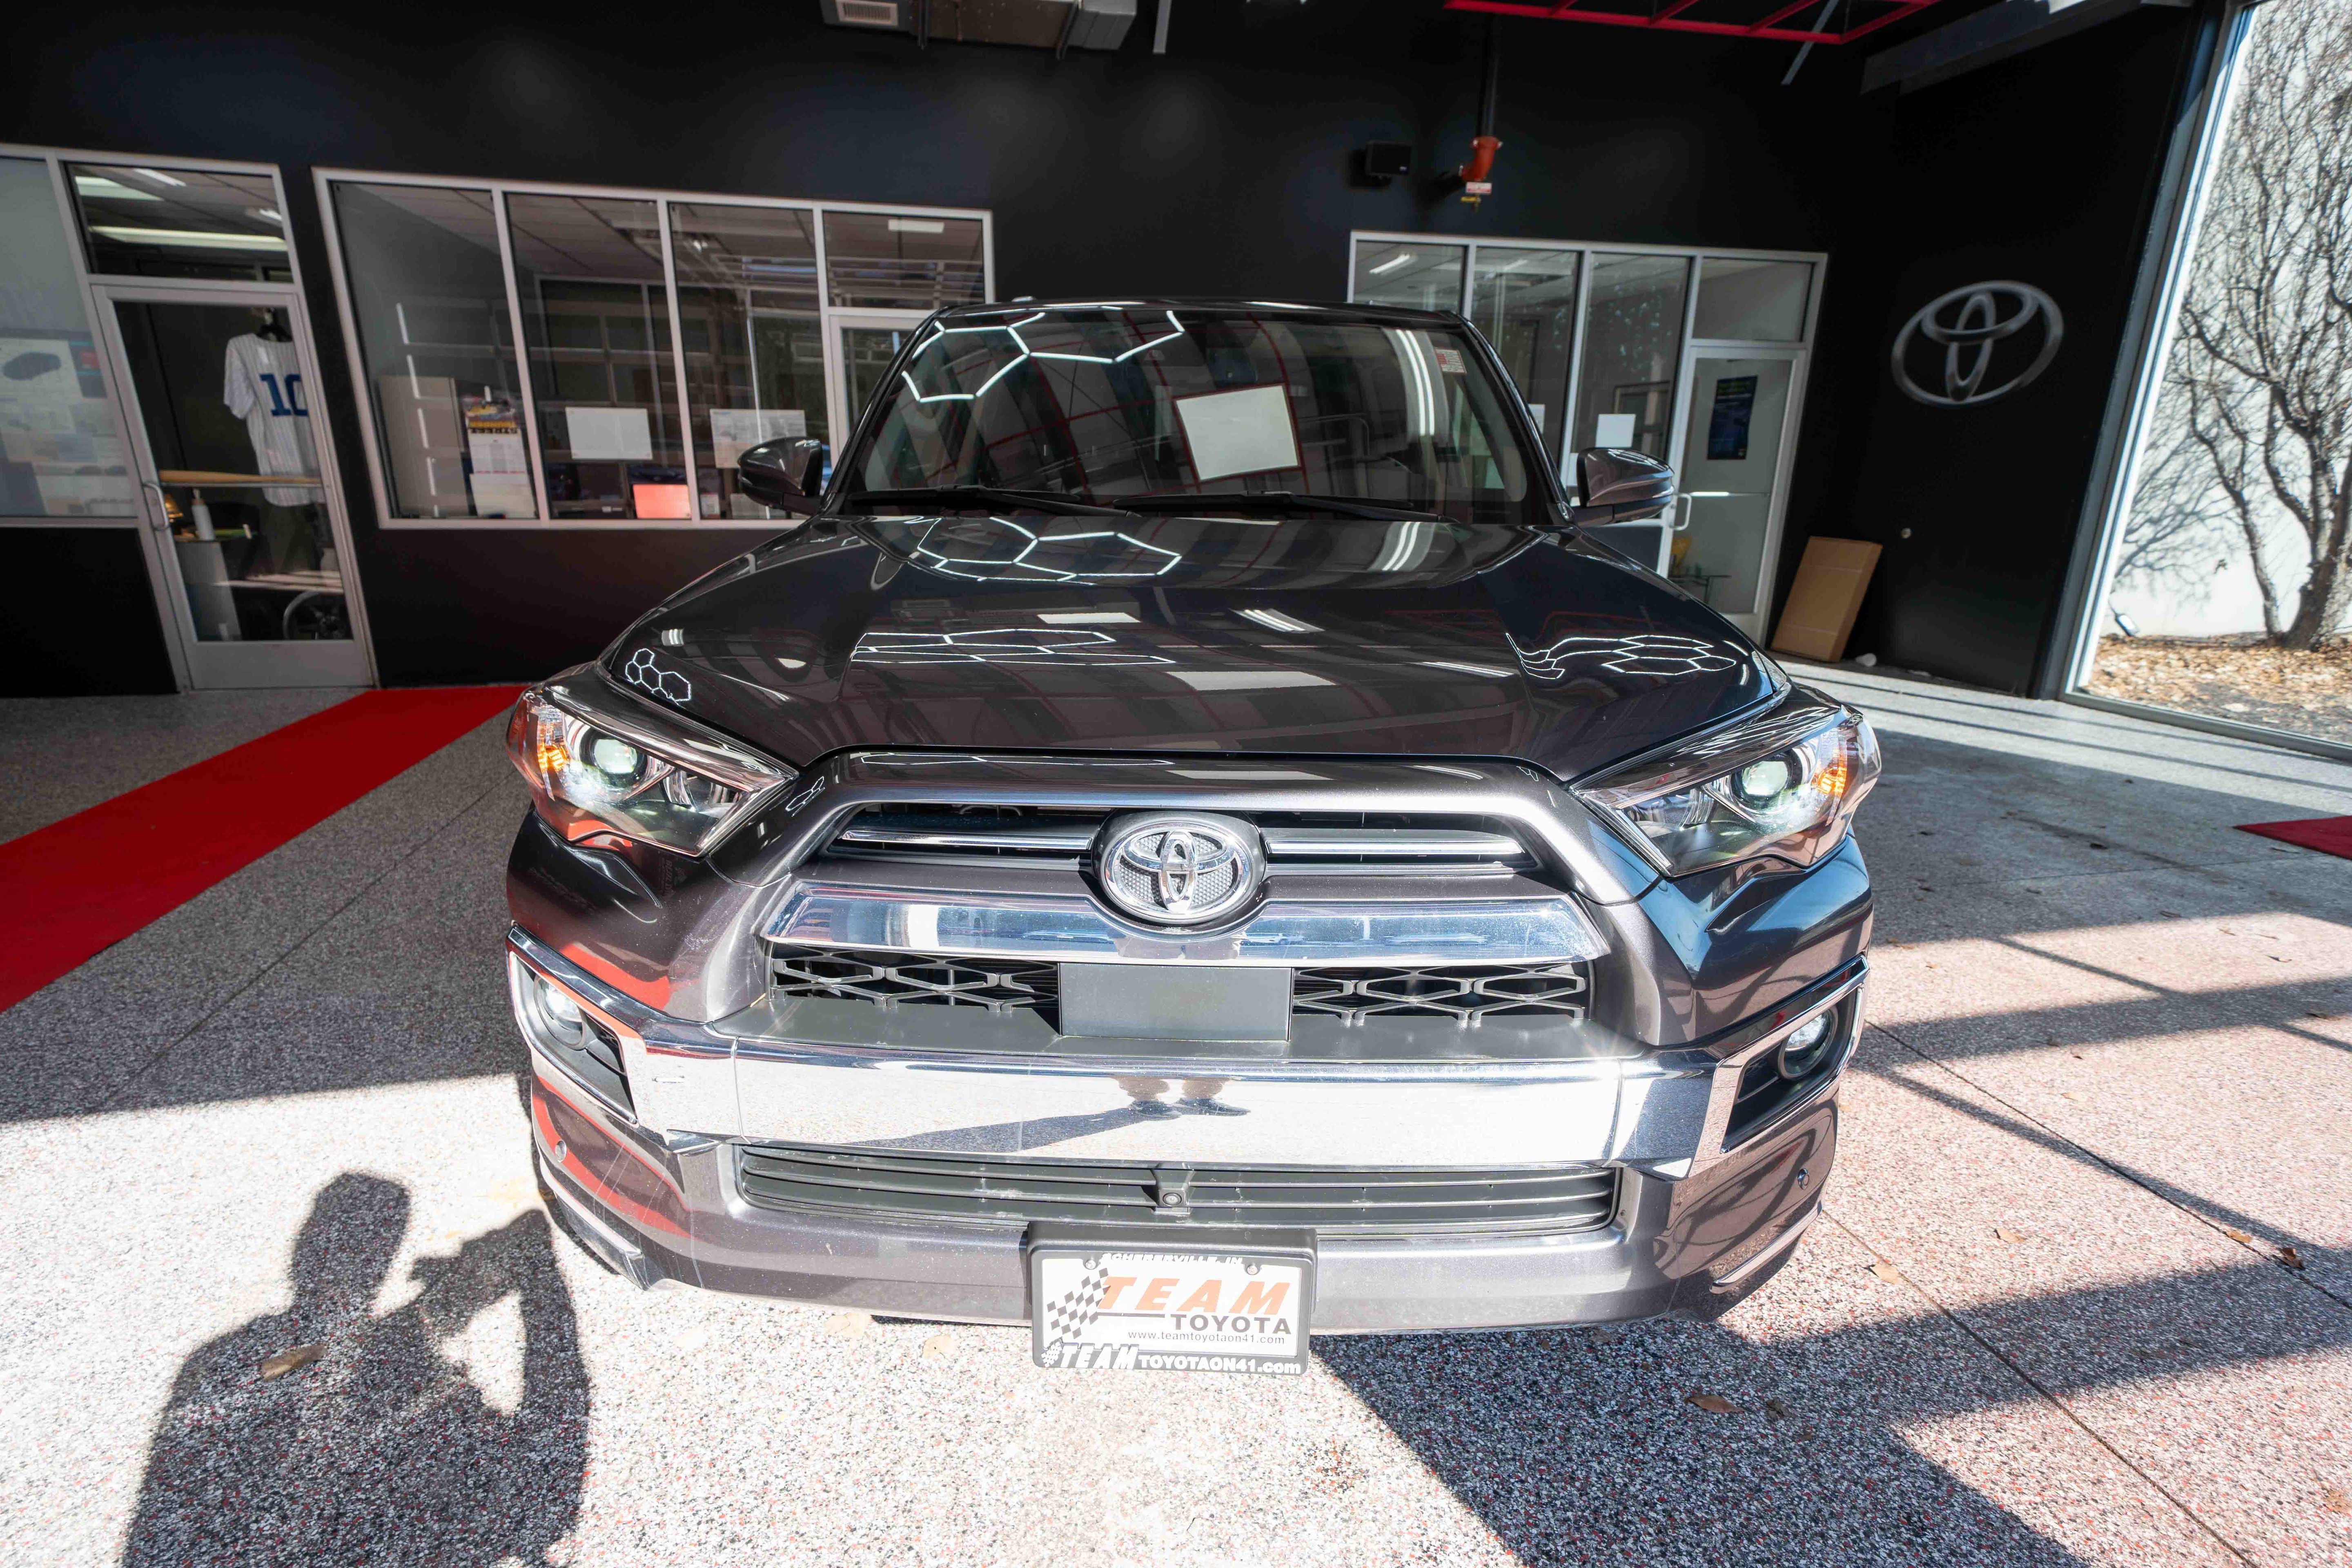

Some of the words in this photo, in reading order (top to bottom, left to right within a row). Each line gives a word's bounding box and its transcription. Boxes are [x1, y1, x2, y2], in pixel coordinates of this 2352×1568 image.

[1097, 1276, 1290, 1315] TEAM
[1170, 1314, 1291, 1334] TOYOTA
[1128, 1330, 1285, 1345] www.teamtoyotaon41.com
[1060, 1343, 1139, 1370] TEAM
